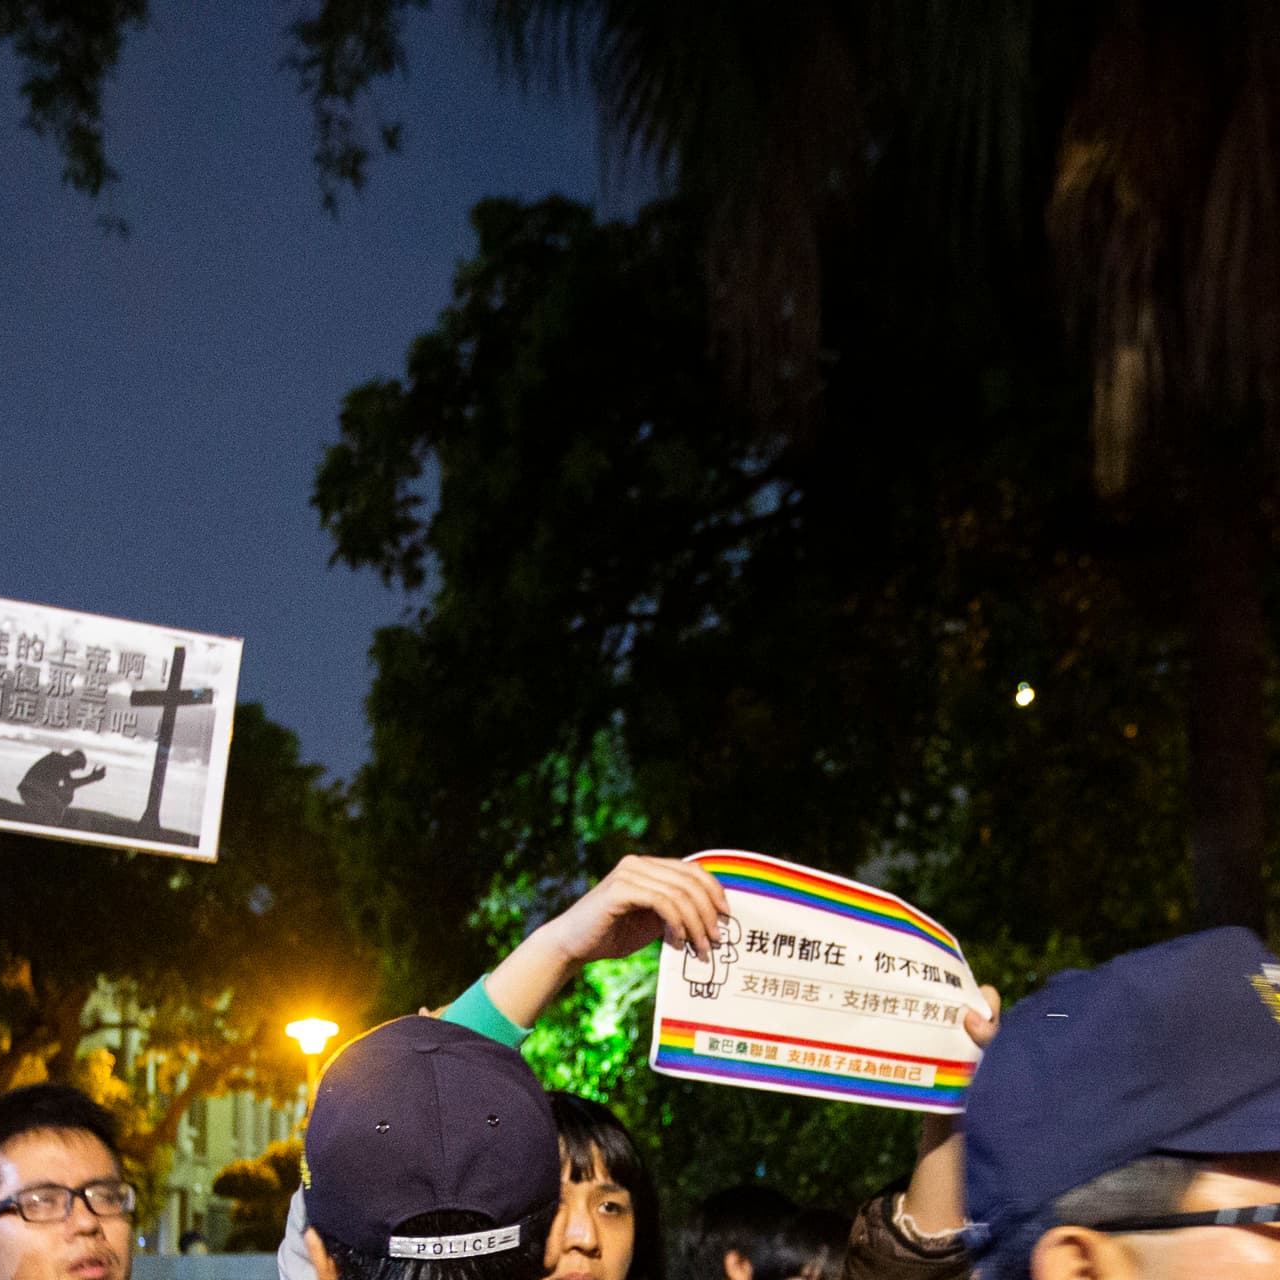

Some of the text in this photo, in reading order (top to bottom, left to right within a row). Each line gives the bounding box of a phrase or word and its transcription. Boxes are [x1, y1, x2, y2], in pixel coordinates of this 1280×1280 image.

[745, 928, 963, 990] 我們都在，你不孤單
[740, 974, 960, 1025] 支持同志，支持性平教育
[708, 1037, 923, 1082] 歐巴桑聯盟 支持孩子成為他自己
[417, 1236, 497, 1255] POLICE
